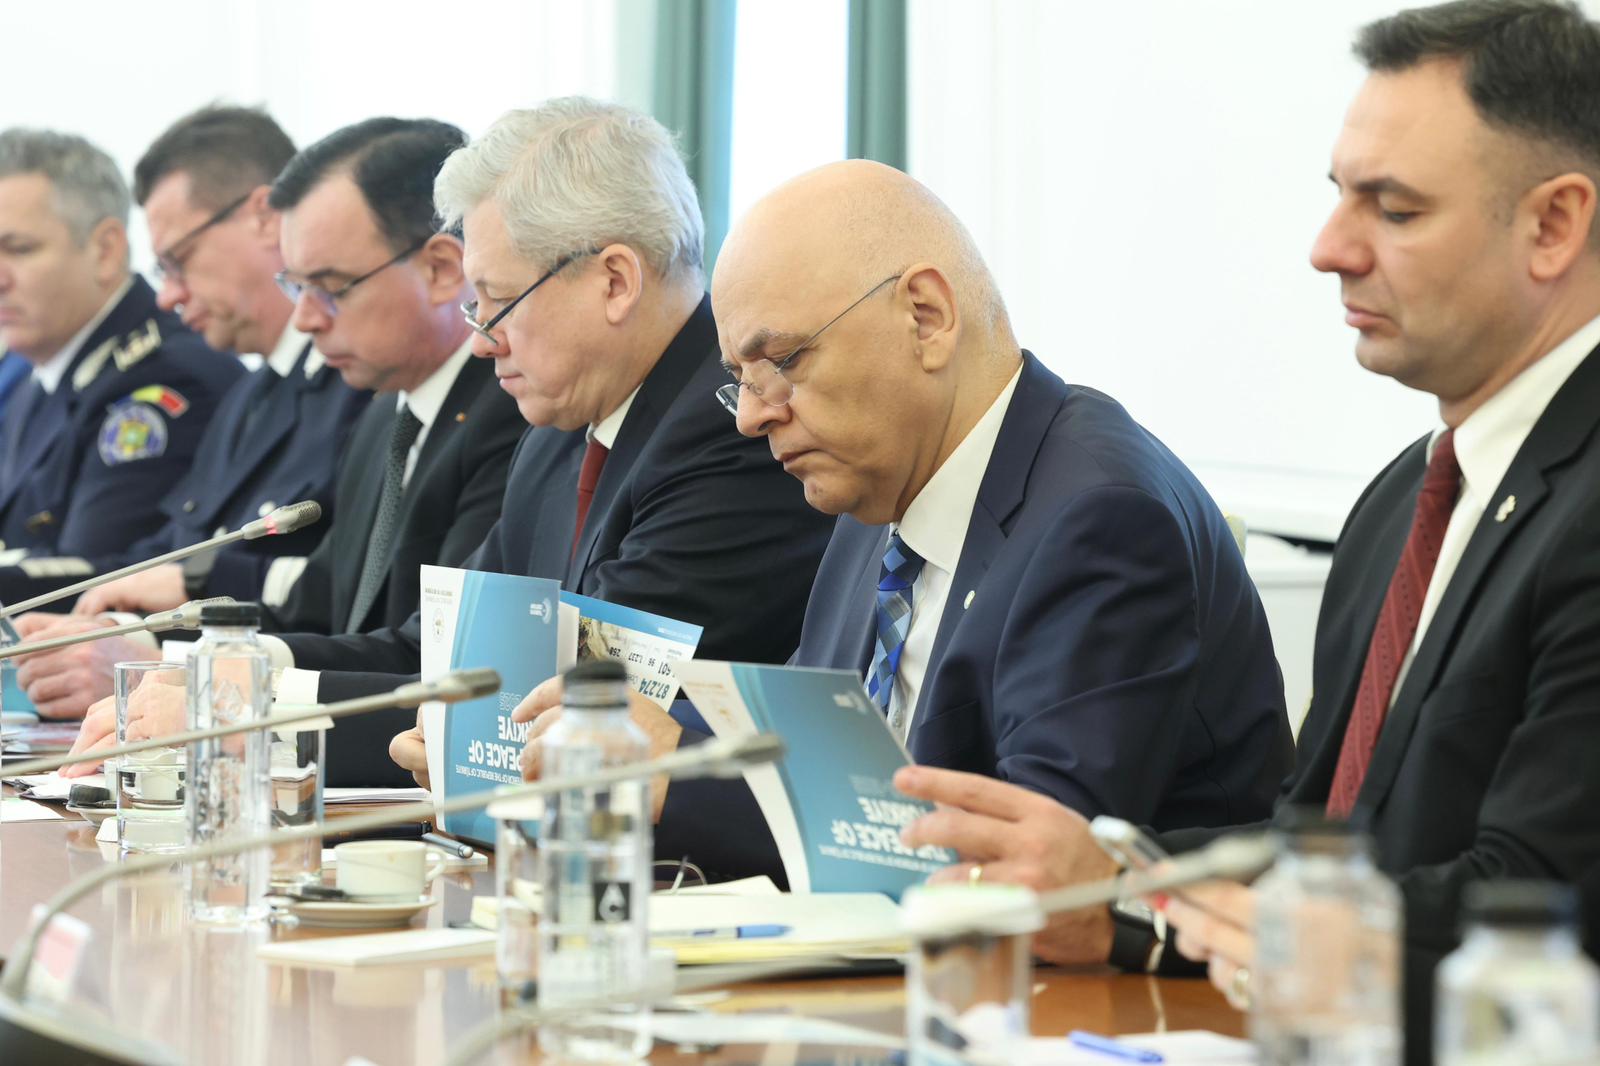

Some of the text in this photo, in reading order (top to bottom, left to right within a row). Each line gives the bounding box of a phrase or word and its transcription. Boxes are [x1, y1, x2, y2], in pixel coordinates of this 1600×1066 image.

[639, 678, 670, 700] 87.274
[468, 739, 522, 772] PEACE OF
[831, 819, 857, 847] OF
